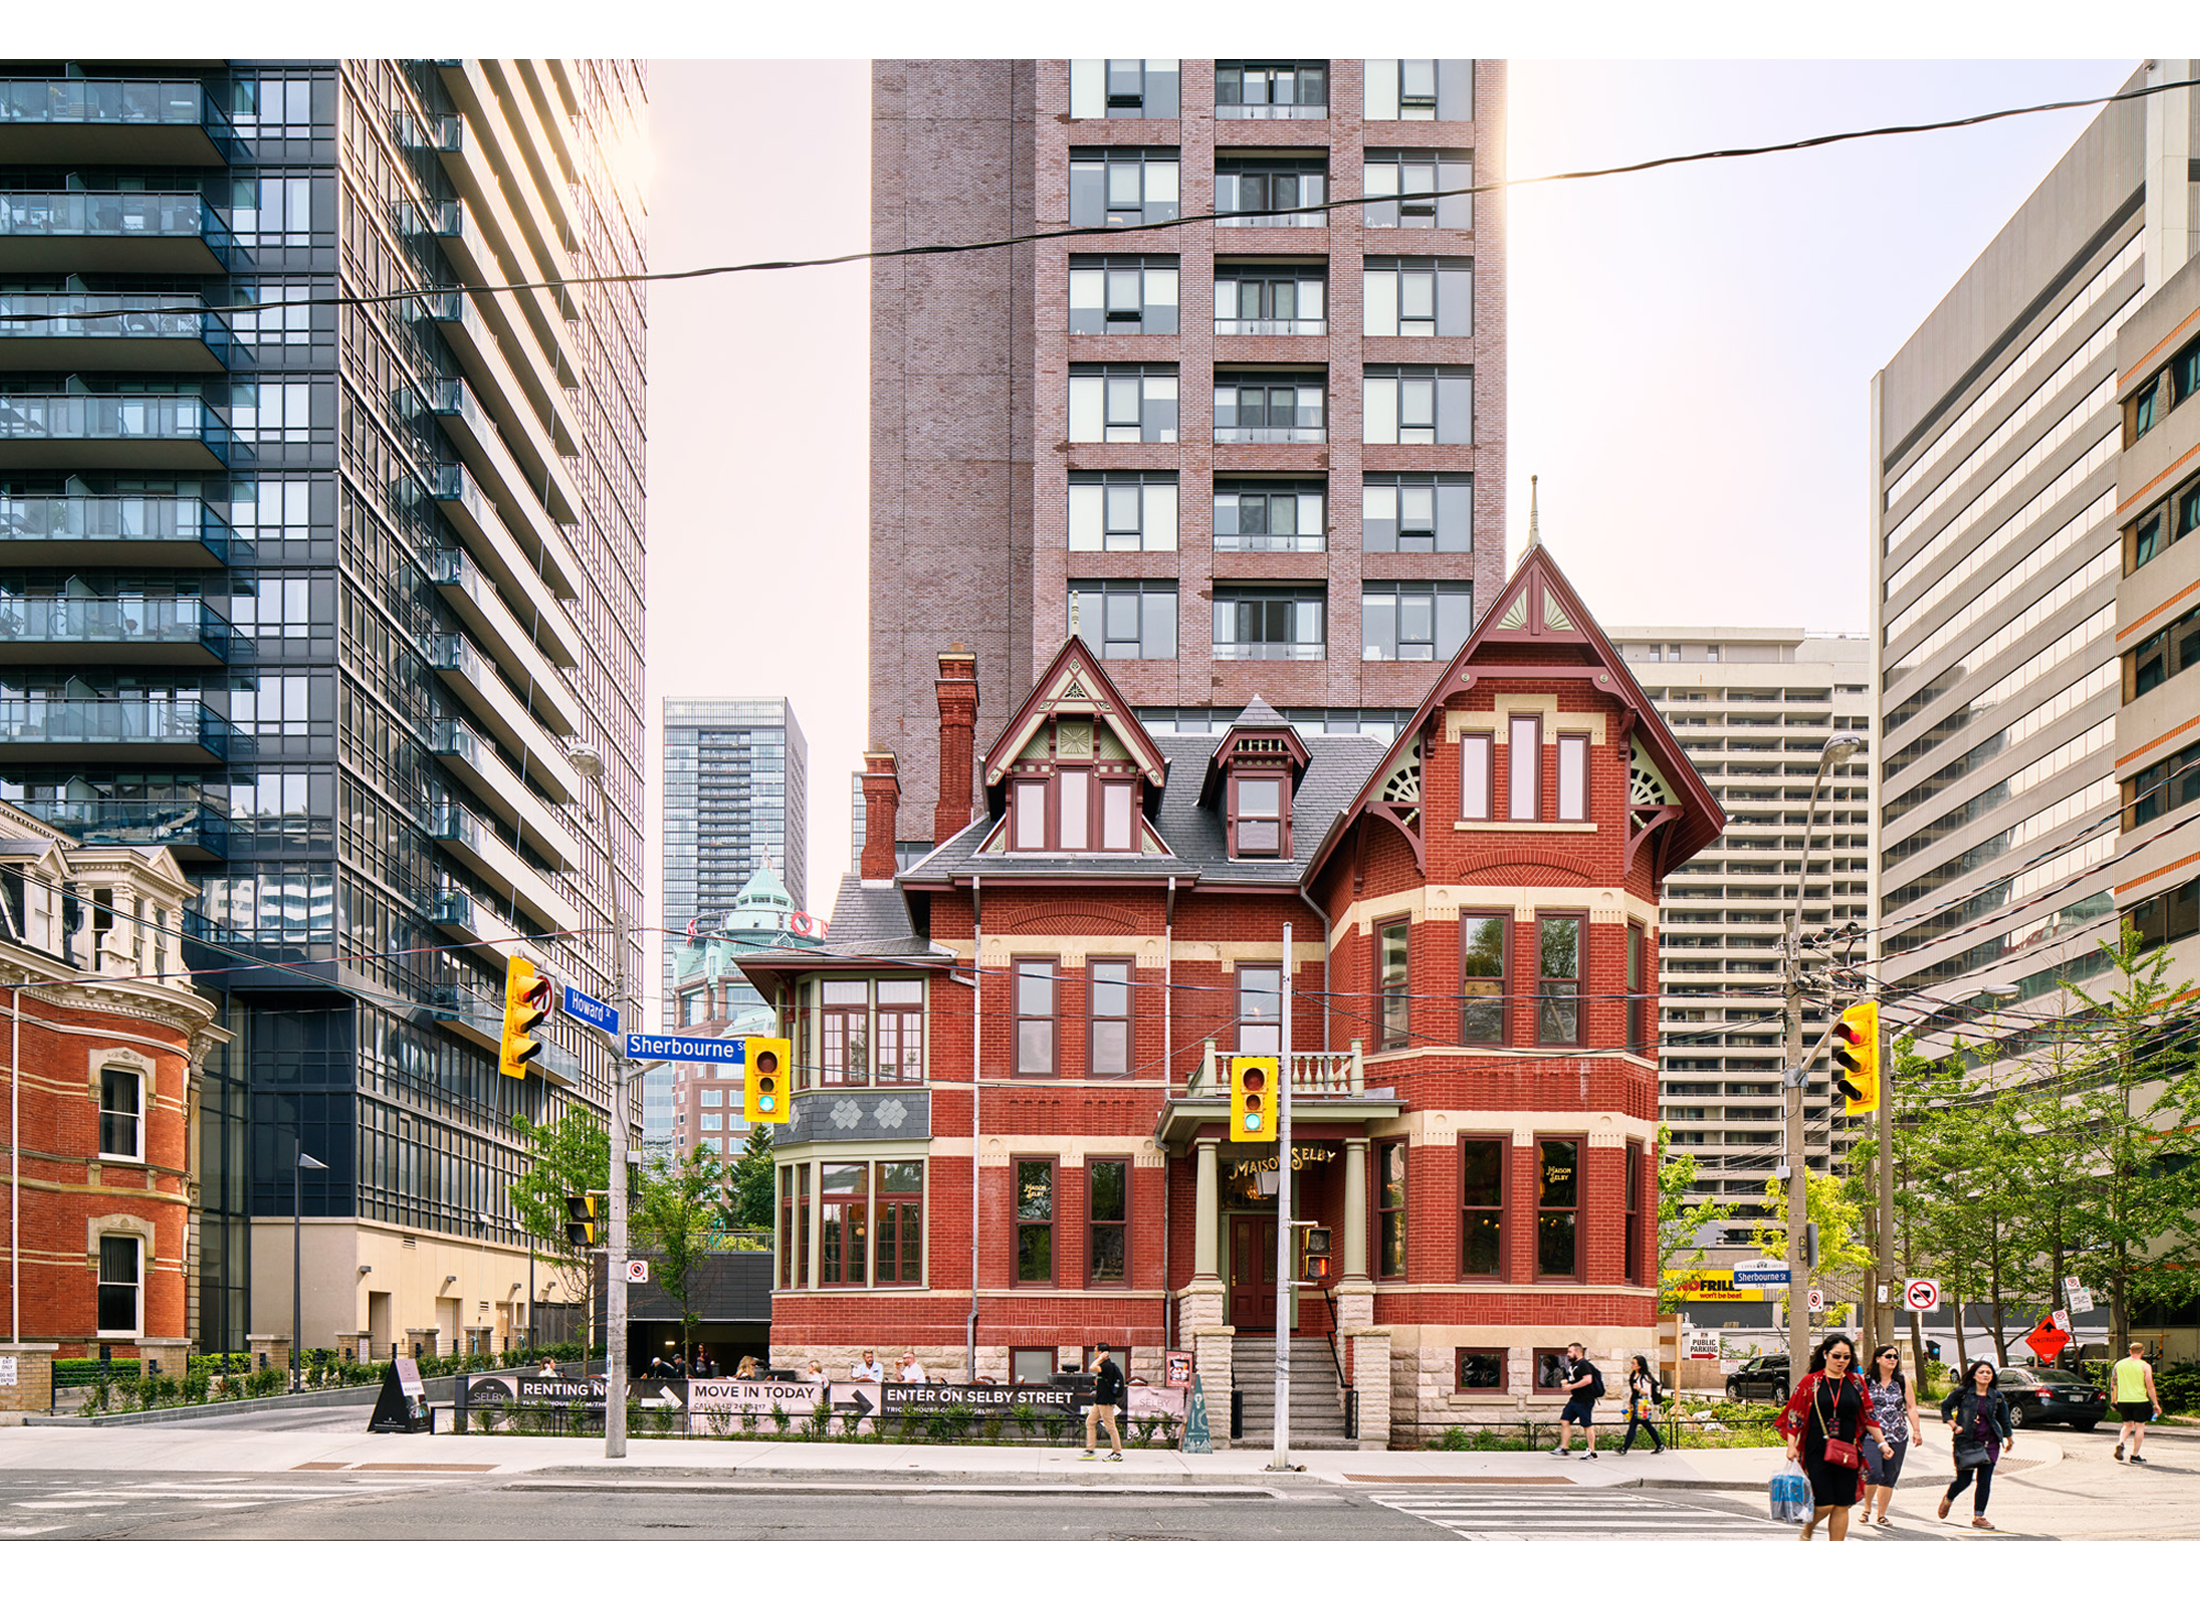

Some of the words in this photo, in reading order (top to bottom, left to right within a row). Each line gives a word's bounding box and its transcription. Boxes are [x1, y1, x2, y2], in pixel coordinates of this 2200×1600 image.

[572, 991, 604, 1022] Howard
[630, 1035, 734, 1058] Sherbourne
[1291, 1147, 1336, 1170] SELBY
[1738, 1272, 1779, 1282] Sherbourne
[1717, 1291, 1727, 1299] be
[1727, 1291, 1742, 1299] beat
[2030, 1336, 2067, 1344] CONSTRUCTION
[523, 1383, 589, 1396] RENTING
[695, 1385, 739, 1398] MOVE
[744, 1386, 759, 1398] IN
[764, 1386, 815, 1399] TODAY
[474, 1392, 506, 1401] SELBY
[887, 1389, 935, 1402] ENTER
[940, 1390, 962, 1402] ON
[967, 1391, 1013, 1404] SELBY
[1018, 1392, 1073, 1404] STREET
[1139, 1398, 1170, 1408] SELBY
